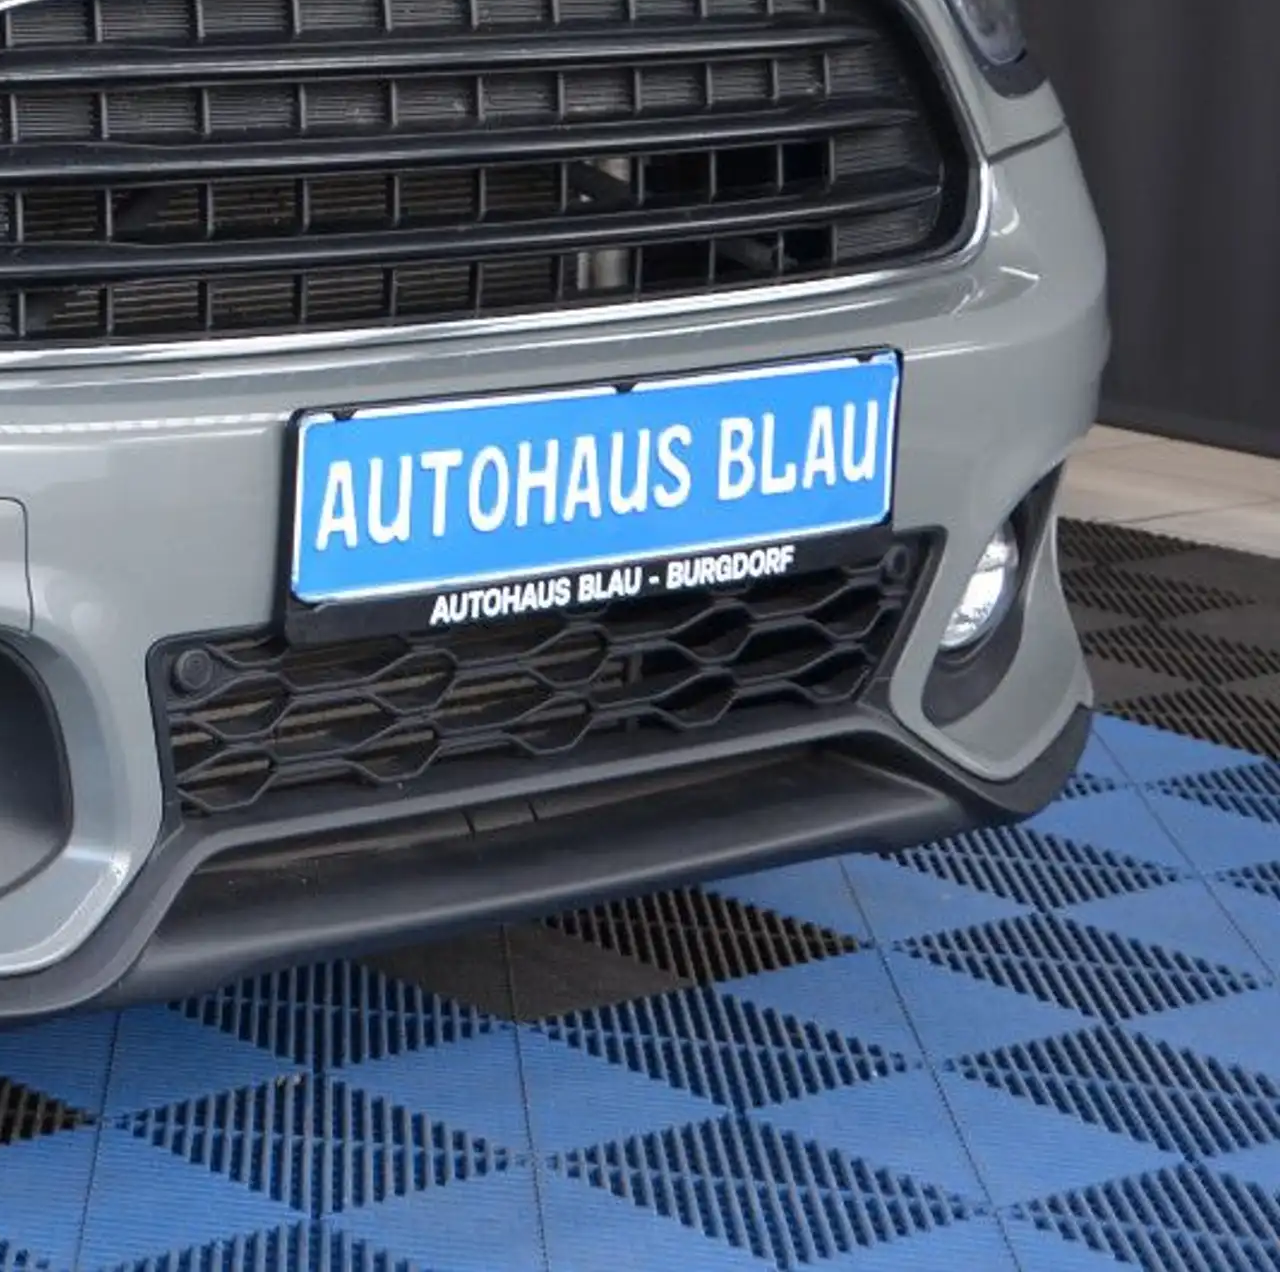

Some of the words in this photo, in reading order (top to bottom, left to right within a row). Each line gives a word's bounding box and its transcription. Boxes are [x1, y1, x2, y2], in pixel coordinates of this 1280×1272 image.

[315, 425, 692, 551] AUTOHAUS
[717, 400, 879, 501] BLAU
[429, 577, 572, 625] AUTOHAUS
[577, 566, 642, 603] BLAU
[666, 546, 795, 589] BURGDORF
